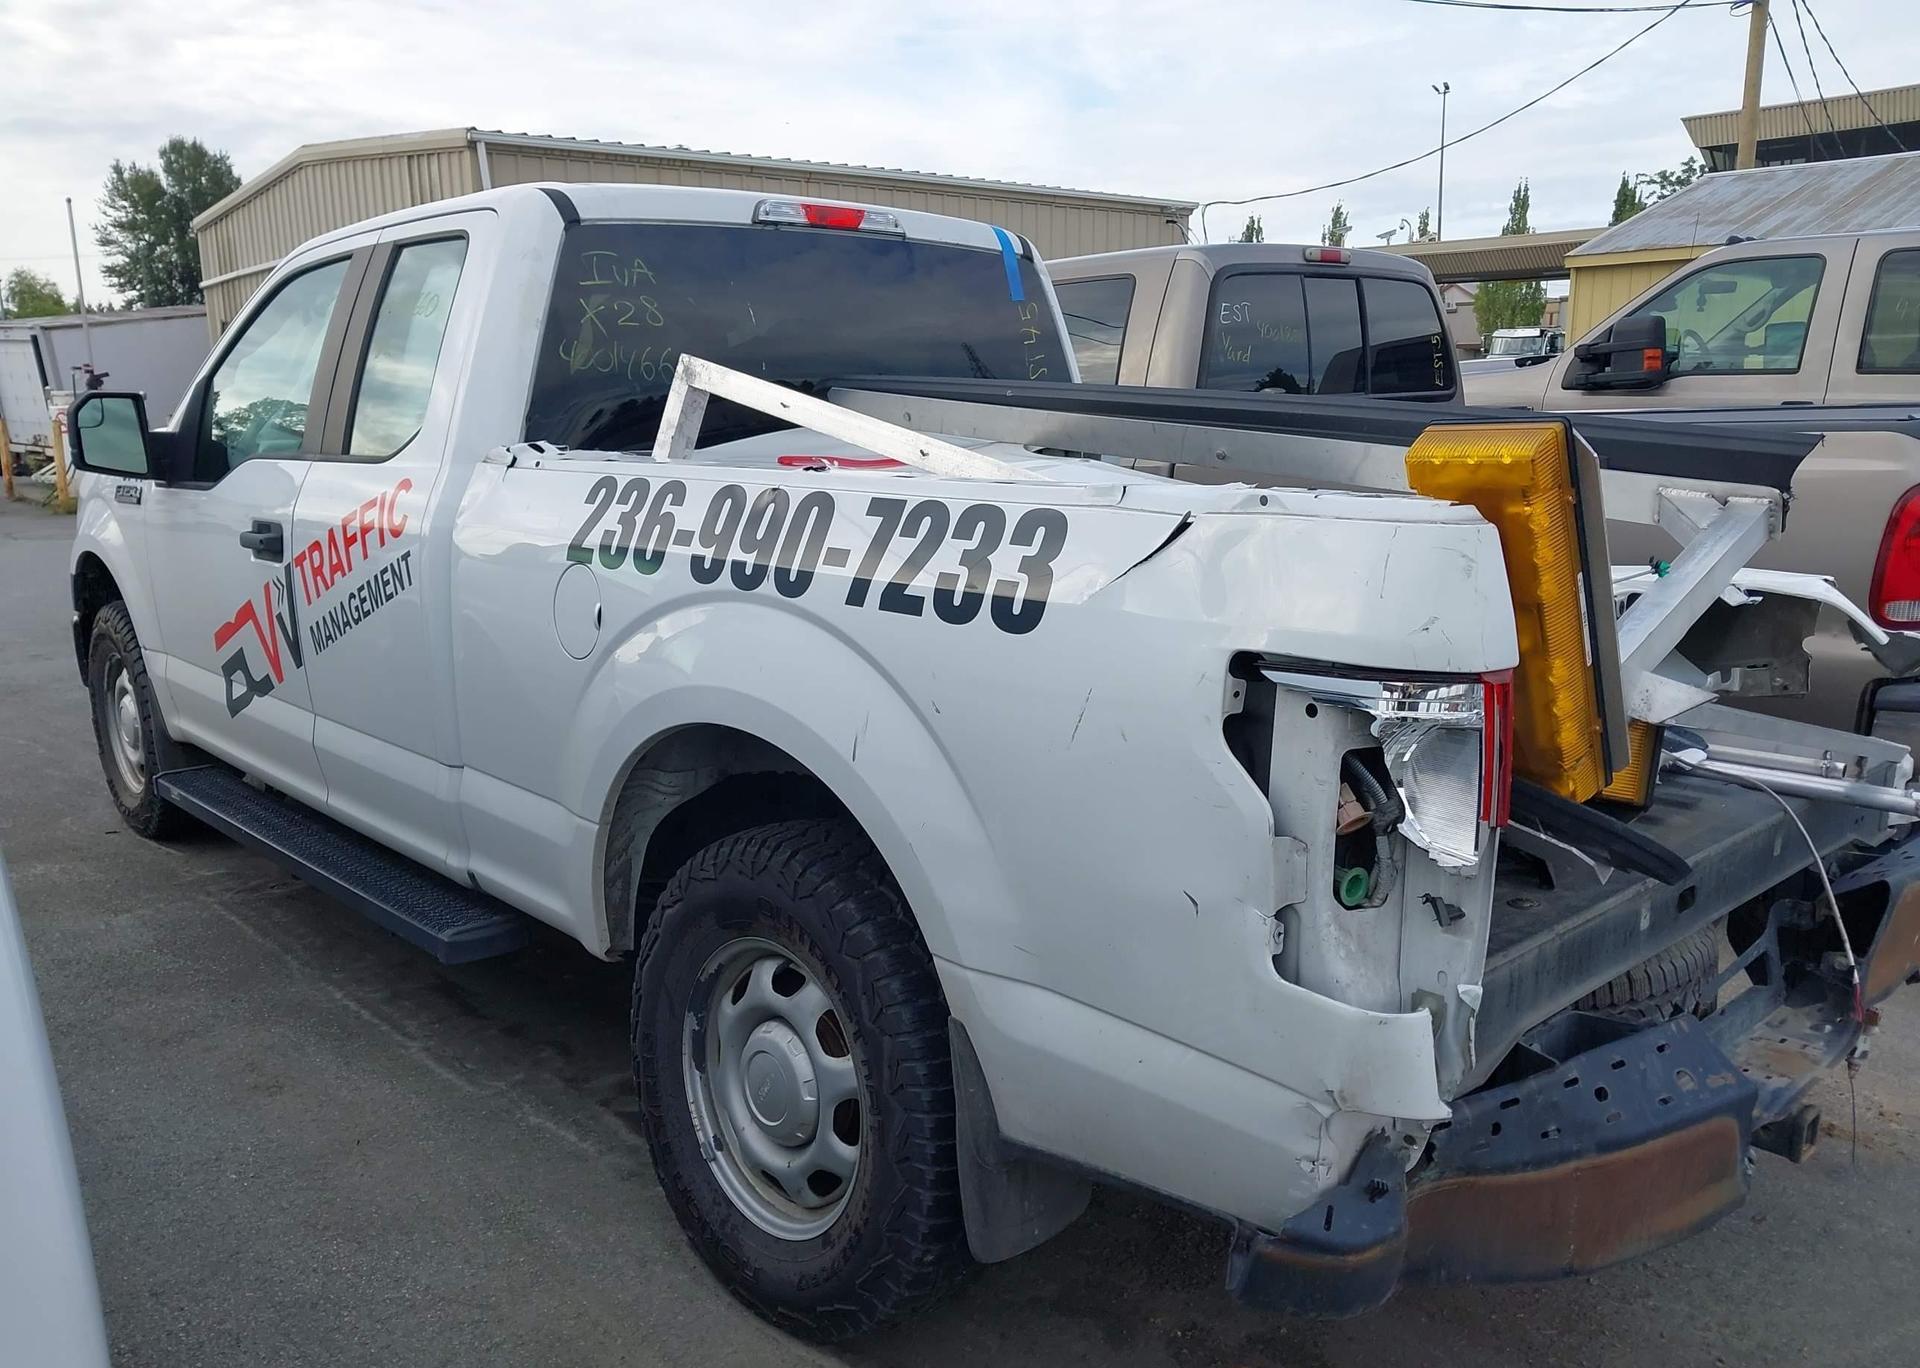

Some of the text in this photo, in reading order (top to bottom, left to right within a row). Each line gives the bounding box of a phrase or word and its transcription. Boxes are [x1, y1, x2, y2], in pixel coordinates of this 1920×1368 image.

[579, 295, 665, 337] X28
[1220, 301, 1252, 324] EST
[294, 478, 413, 607] TRAFFIC
[566, 475, 1069, 635] 236-990-7233
[309, 550, 413, 656] MANAGEMENT
